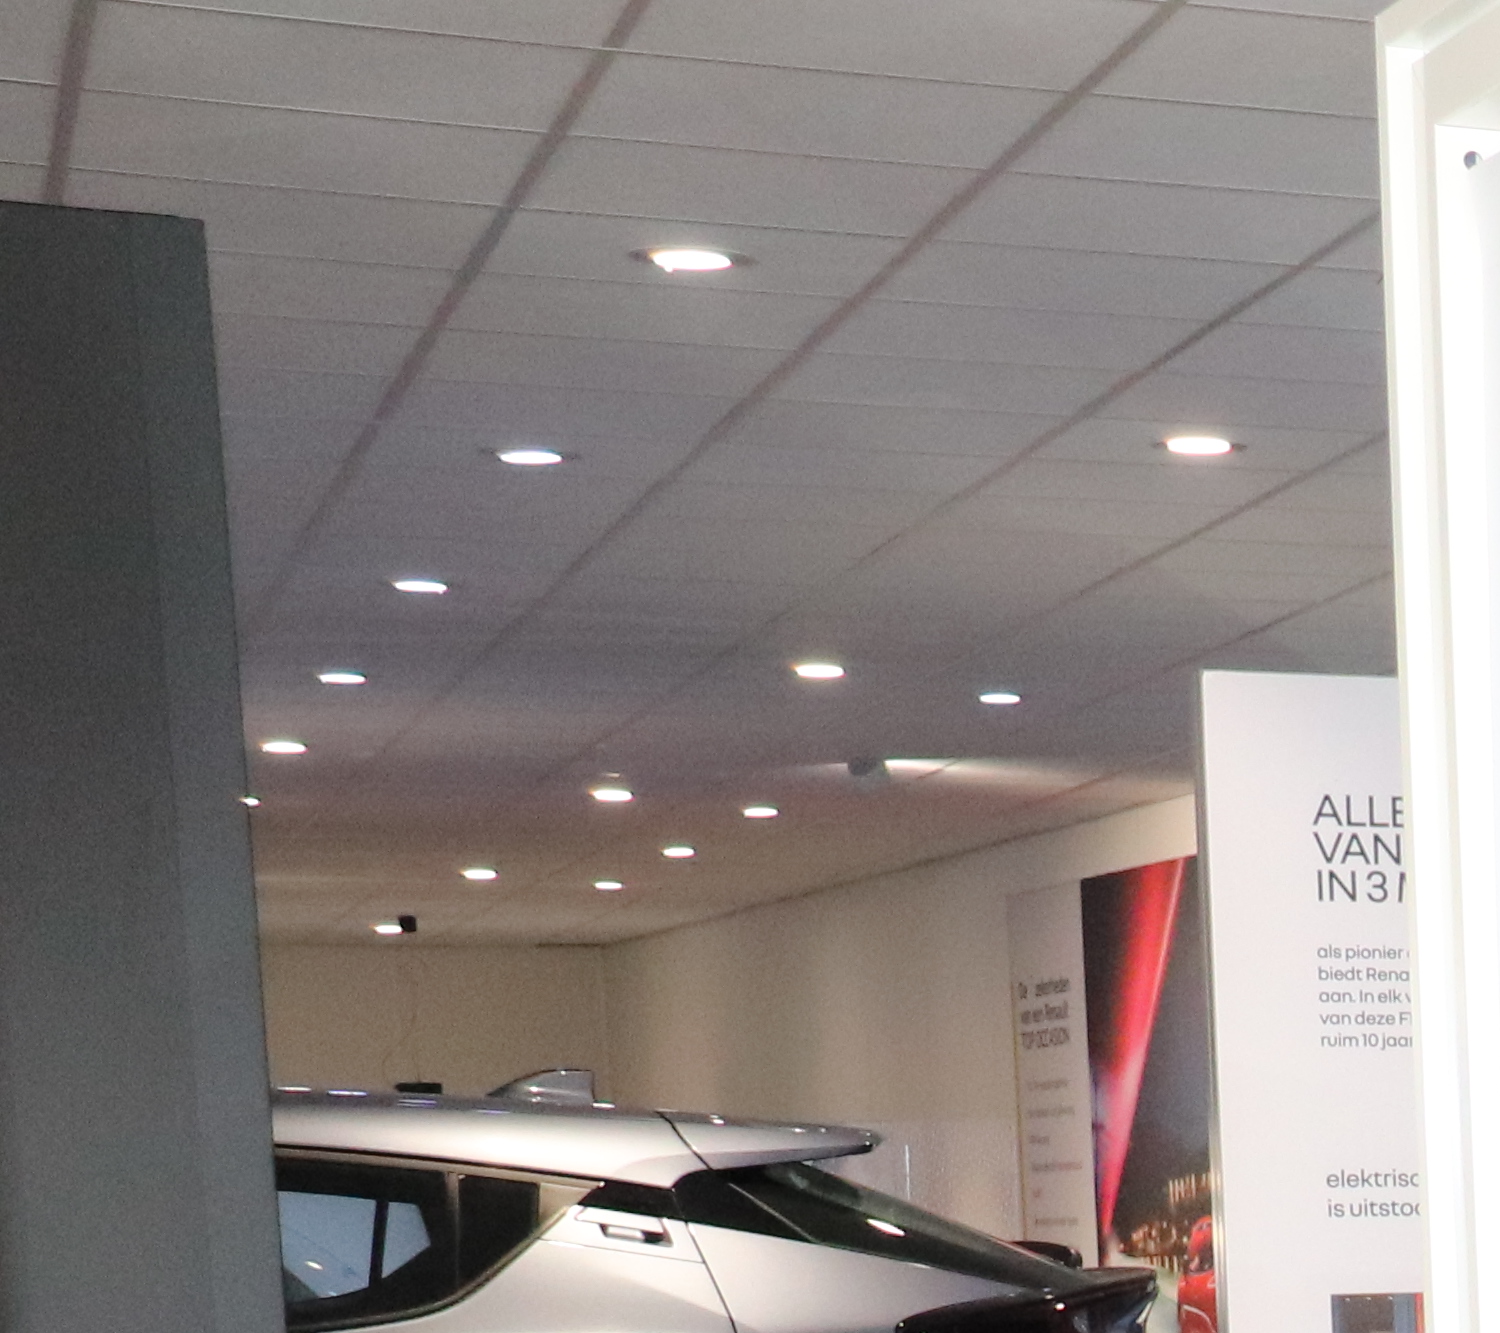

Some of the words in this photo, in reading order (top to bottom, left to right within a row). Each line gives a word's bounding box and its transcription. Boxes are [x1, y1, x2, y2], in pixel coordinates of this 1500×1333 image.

[1314, 832, 1402, 866] VAN
[1317, 869, 1357, 902] IN
[1366, 871, 1389, 903] 3
[1317, 944, 1342, 961] als
[1345, 942, 1405, 964] pionier
[1317, 965, 1363, 983] biedt
[1318, 989, 1356, 1004] aan.
[1358, 988, 1376, 1004] In
[1377, 987, 1403, 1005] elk
[1320, 1011, 1352, 1027] van
[1354, 1008, 1396, 1026] deze
[1320, 1031, 1360, 1049] ruim
[1362, 1031, 1379, 1049] 10
[1327, 1198, 1345, 1218] is
